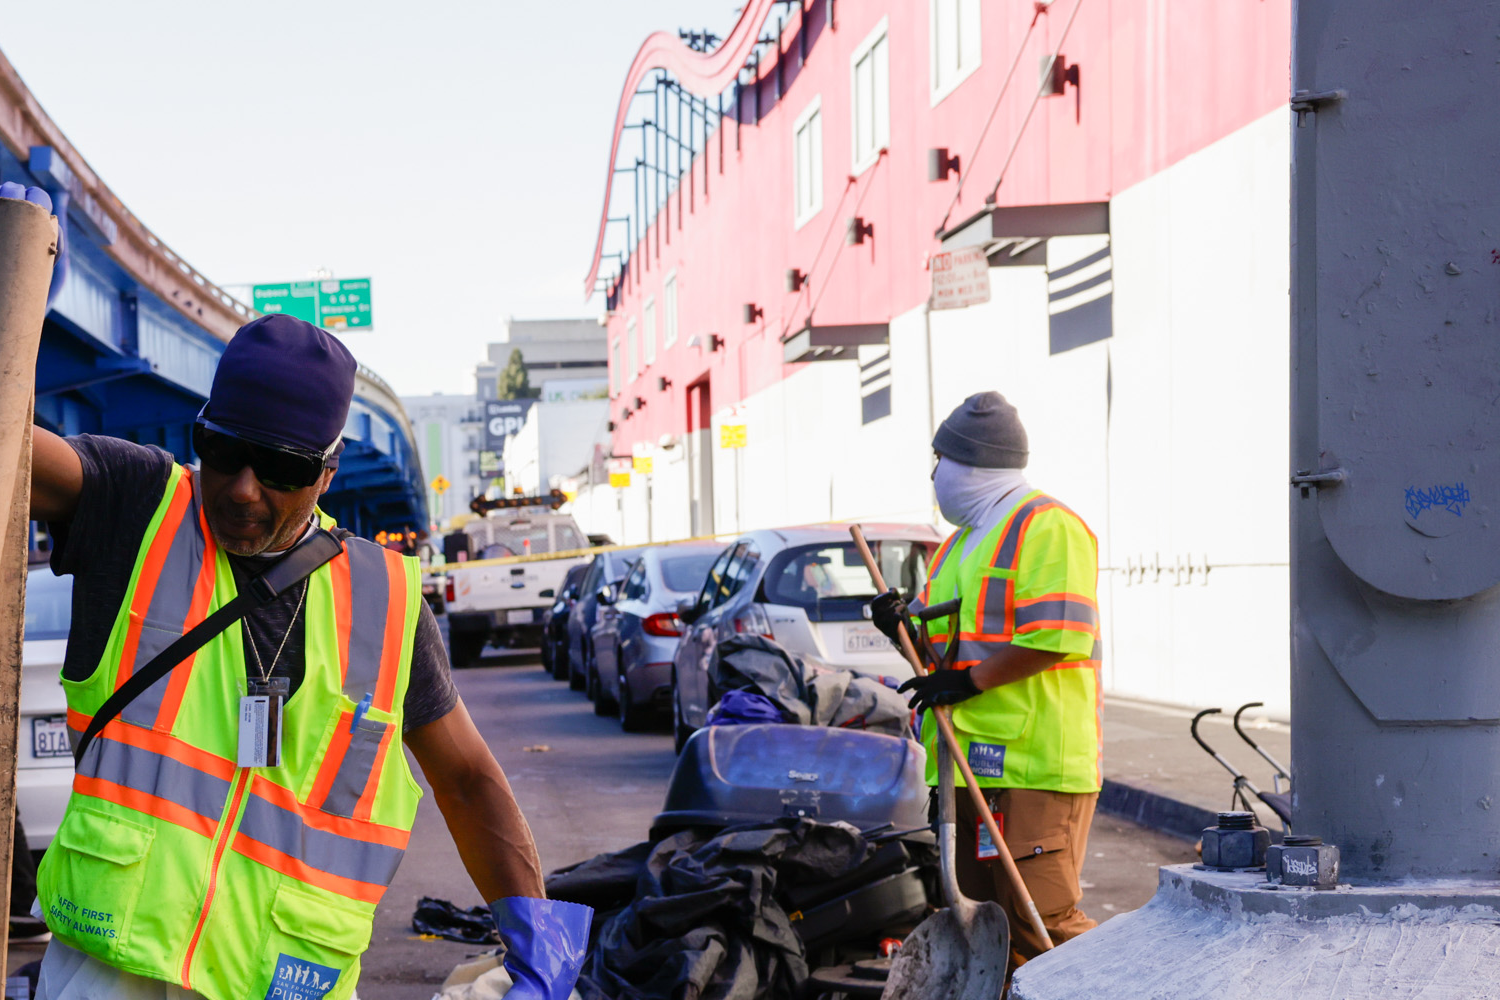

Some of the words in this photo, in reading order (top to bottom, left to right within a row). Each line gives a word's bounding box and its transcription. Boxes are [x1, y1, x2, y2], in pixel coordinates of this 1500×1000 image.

[82, 908, 114, 923] FIRST.
[73, 921, 118, 939] ALWAYS.
[276, 980, 288, 988] SAN
